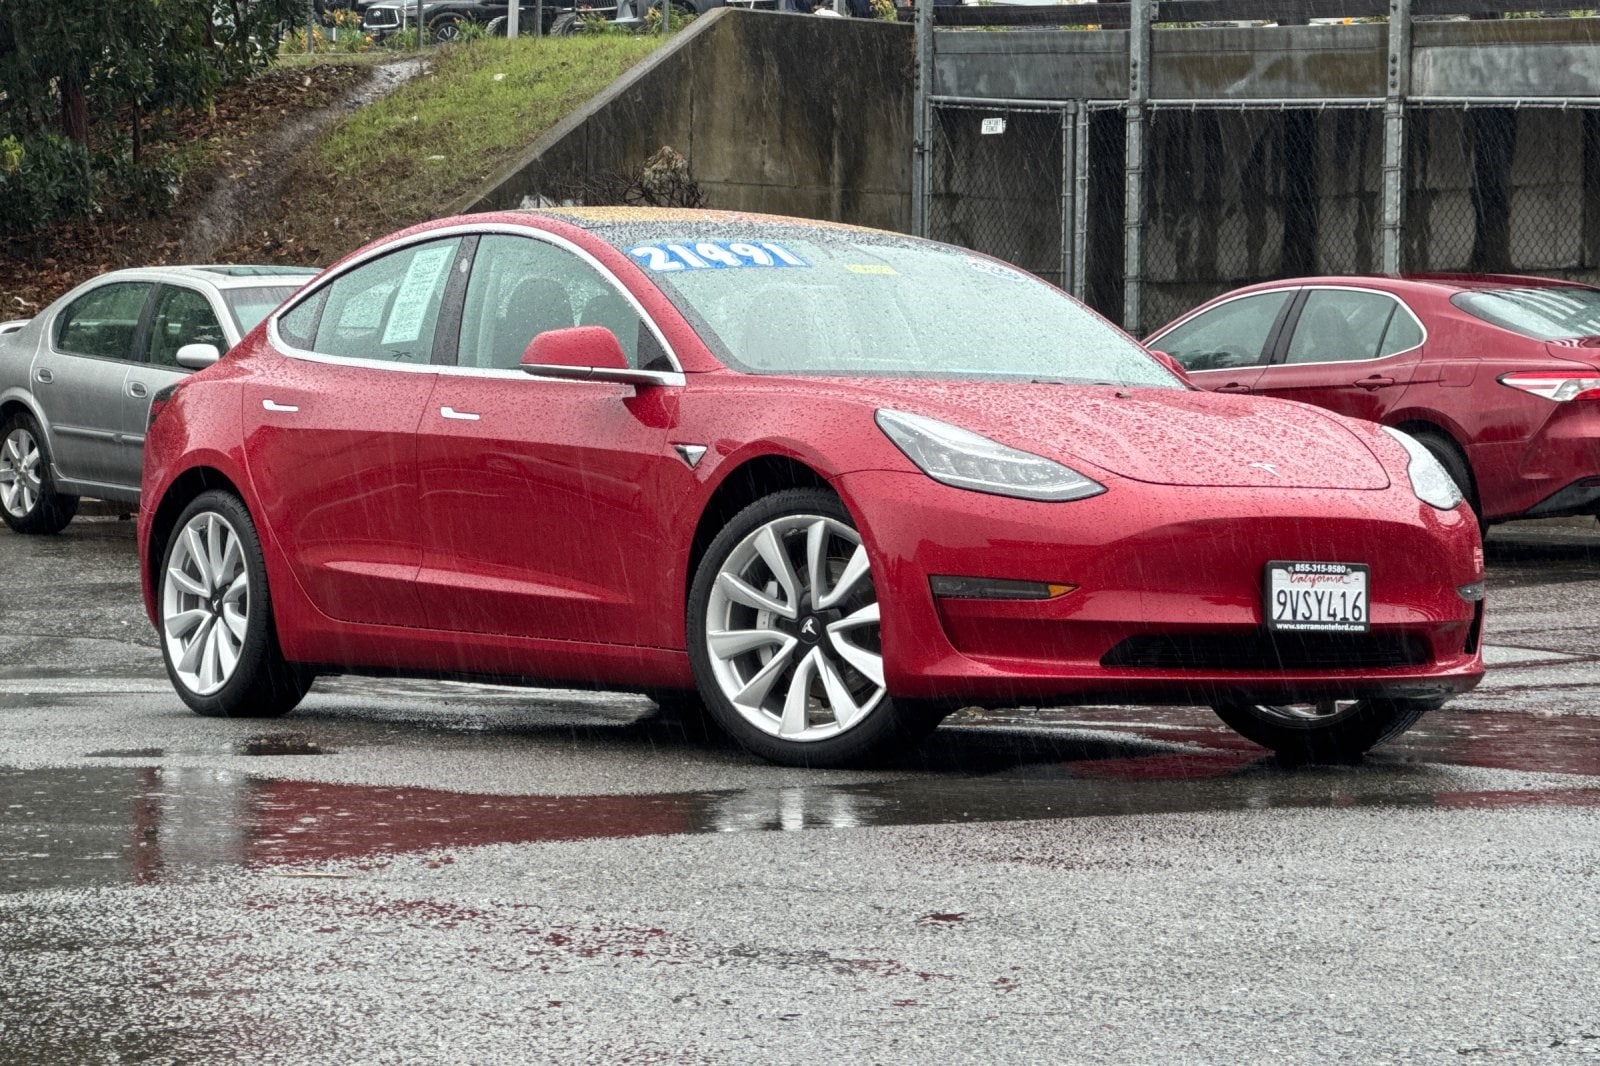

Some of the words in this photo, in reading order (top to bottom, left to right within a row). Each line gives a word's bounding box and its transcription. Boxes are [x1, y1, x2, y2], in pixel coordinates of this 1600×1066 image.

[1294, 563, 1346, 573] 855-315-9580
[1290, 573, 1349, 588] California
[1276, 589, 1362, 621] 9VSY416
[1276, 623, 1365, 631] www.serramonteford.com
